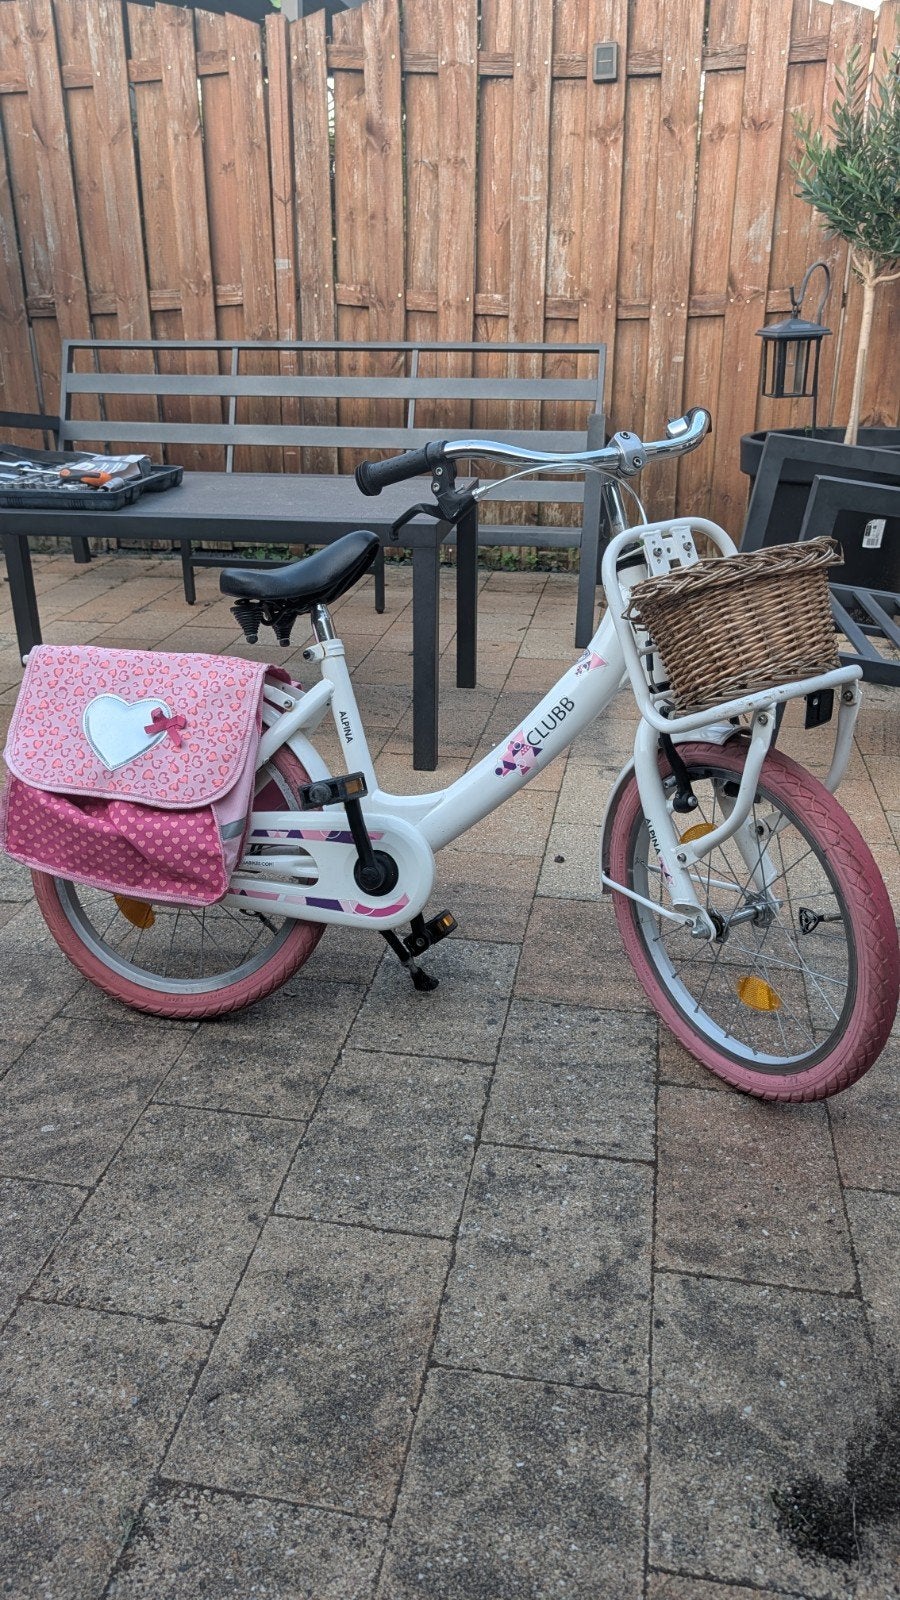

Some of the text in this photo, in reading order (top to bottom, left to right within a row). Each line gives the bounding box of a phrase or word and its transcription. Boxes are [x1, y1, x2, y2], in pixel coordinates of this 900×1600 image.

[339, 711, 354, 744] ALPINA
[526, 697, 575, 746] CLUBB
[645, 818, 661, 855] ALPINA
